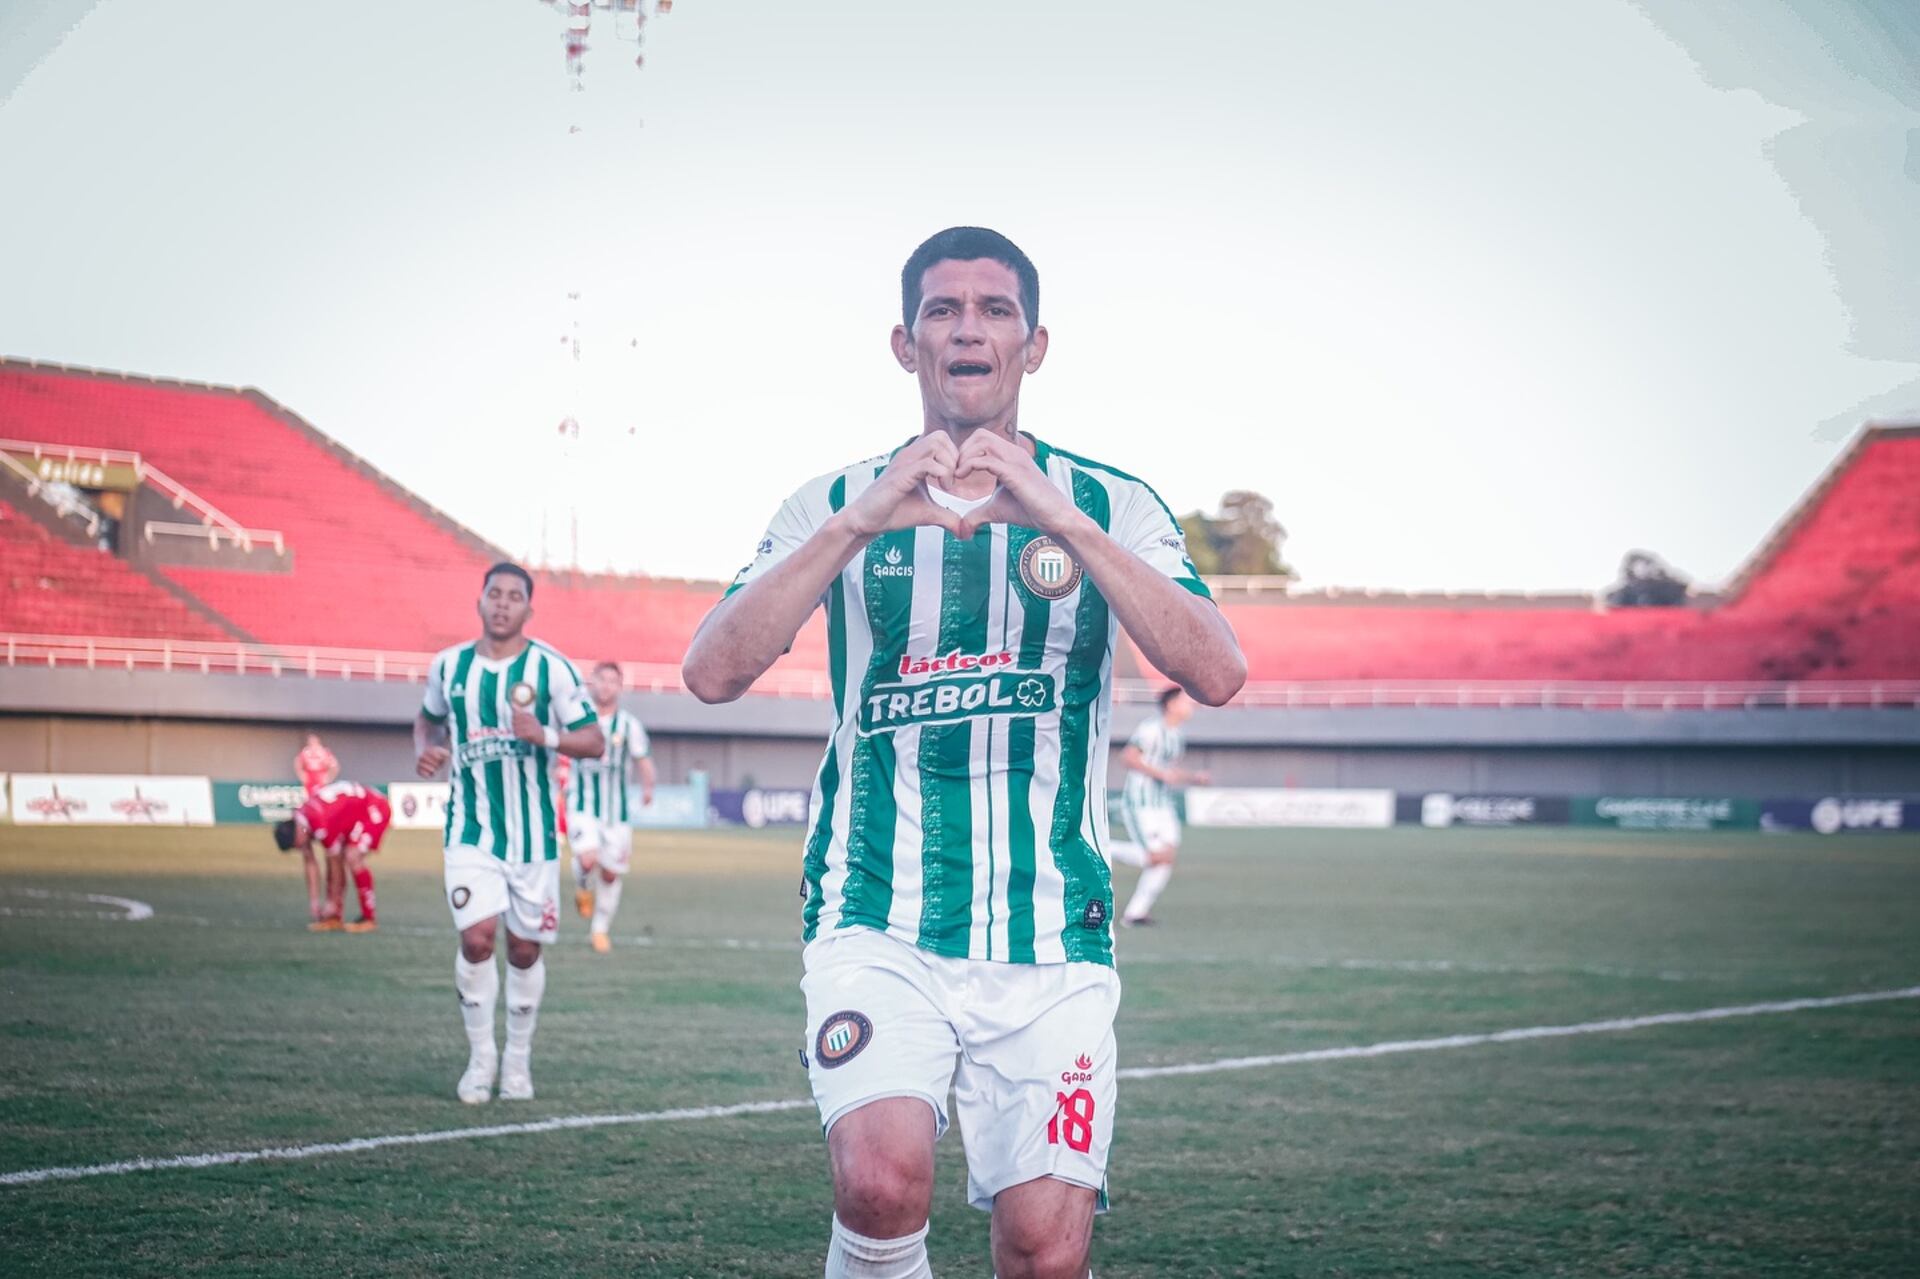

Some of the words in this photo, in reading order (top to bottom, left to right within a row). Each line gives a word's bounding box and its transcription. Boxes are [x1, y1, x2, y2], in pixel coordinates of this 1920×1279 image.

[873, 564, 914, 579] GARCIS
[900, 650, 1012, 675] lácteos
[868, 678, 1012, 723] TREBOL
[1047, 1088, 1095, 1154] 18
